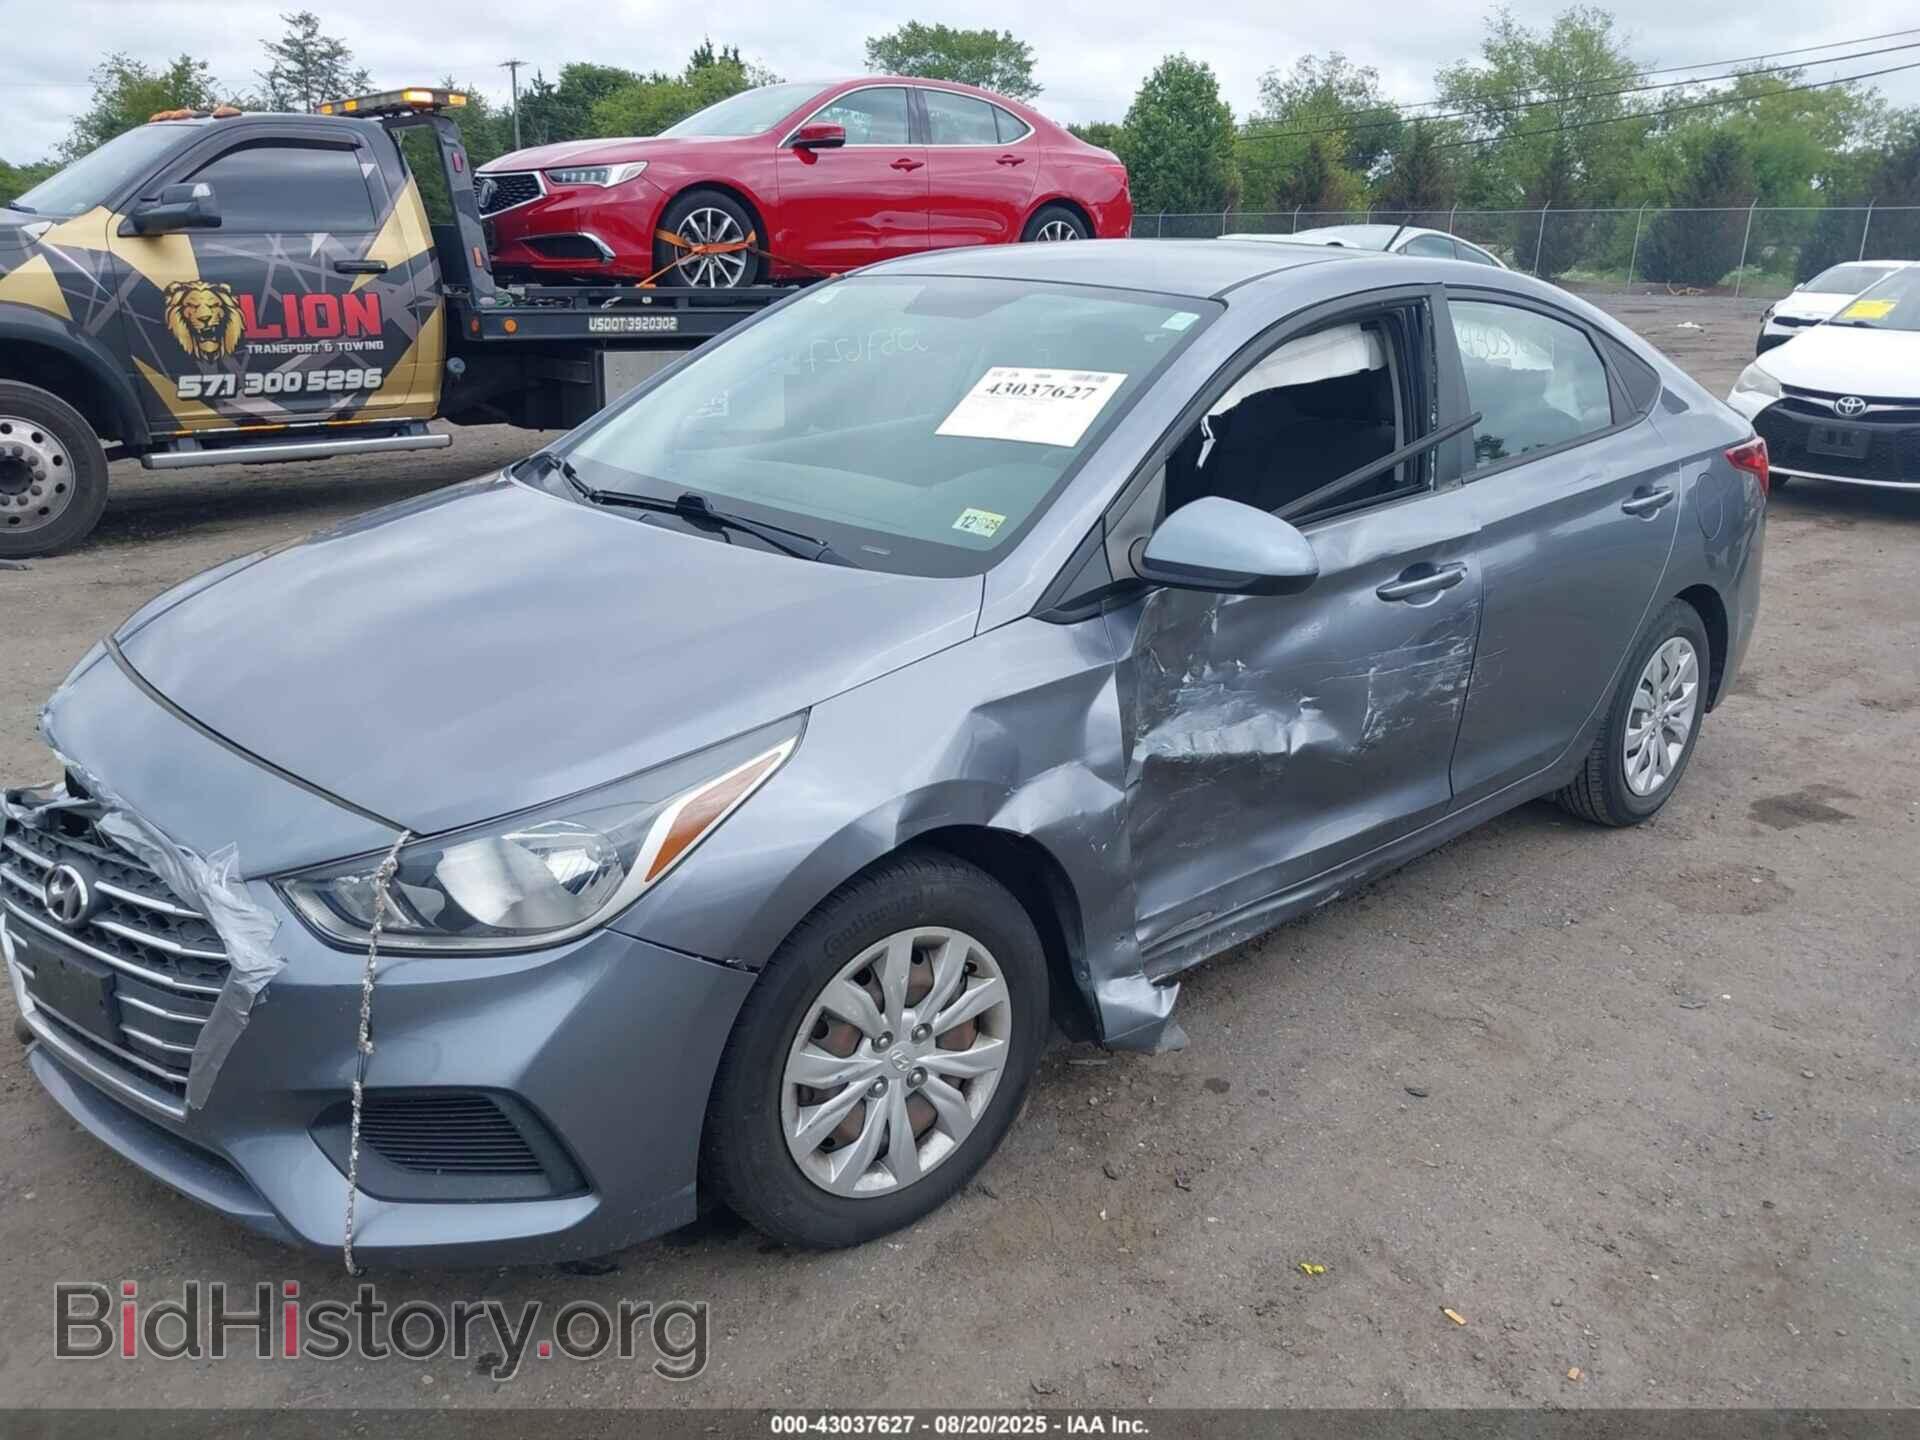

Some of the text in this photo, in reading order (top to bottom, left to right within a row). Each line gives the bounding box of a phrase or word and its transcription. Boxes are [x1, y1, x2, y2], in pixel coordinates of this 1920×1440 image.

[239, 293, 383, 338] LION
[588, 316, 678, 331] USDOT 3920302
[246, 340, 384, 354] TRANSPORT & TOWING
[177, 367, 384, 398] 571 300 5296
[986, 382, 1097, 400] 43037627
[960, 515, 977, 528] 12
